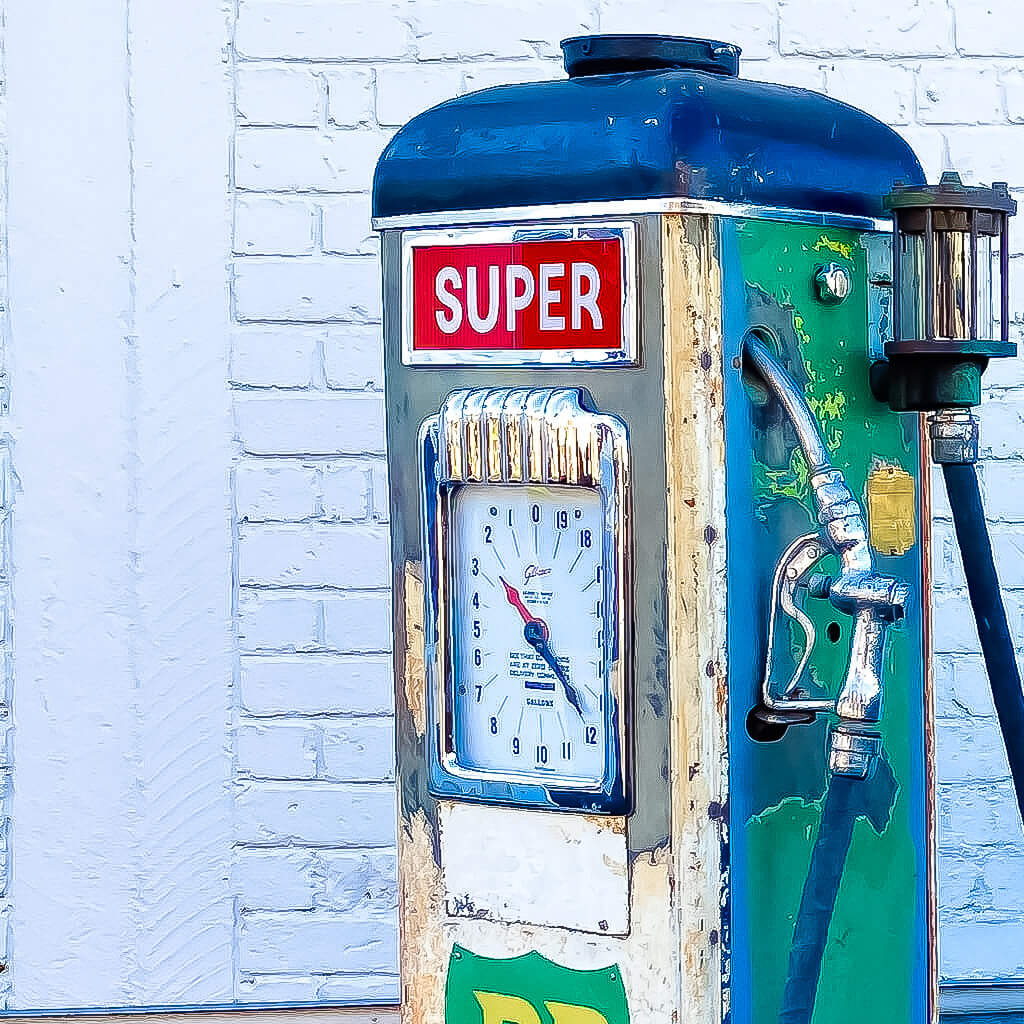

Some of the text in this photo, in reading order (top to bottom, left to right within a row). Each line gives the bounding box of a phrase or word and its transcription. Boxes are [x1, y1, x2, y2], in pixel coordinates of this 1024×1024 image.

[435, 262, 603, 334] SUPER
[508, 509, 513, 526] 1
[532, 504, 540, 522] 0
[556, 510, 568, 529] 19
[484, 525, 492, 543] 2
[580, 529, 592, 548] 18
[472, 558, 479, 576] 3
[473, 592, 480, 609] 4
[473, 620, 480, 638] 5
[474, 649, 481, 666] 6
[475, 684, 482, 702] 7
[490, 716, 498, 734] 8
[585, 726, 597, 744] 12
[512, 737, 520, 754] 9
[536, 745, 548, 764] 10
[562, 741, 571, 760] 11
